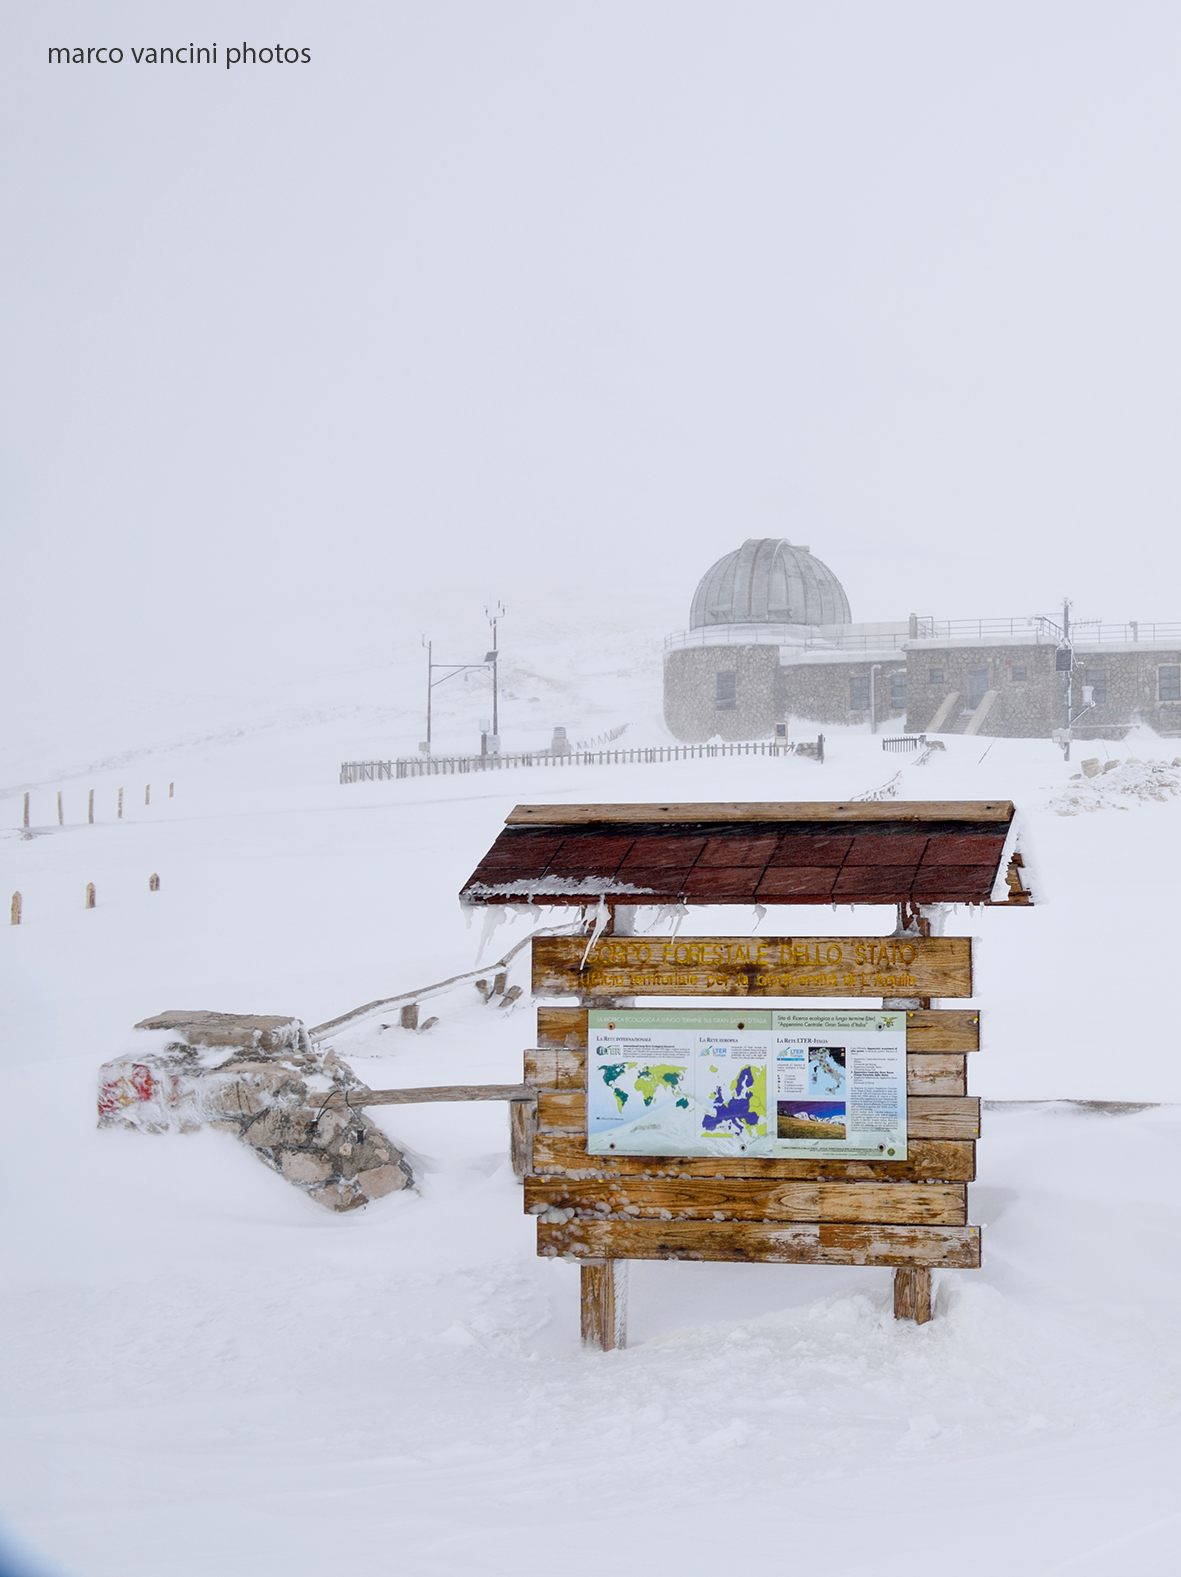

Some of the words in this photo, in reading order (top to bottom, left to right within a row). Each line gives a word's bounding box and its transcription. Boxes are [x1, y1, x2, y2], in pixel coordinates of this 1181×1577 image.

[584, 943, 652, 964] CORPO
[662, 943, 769, 965] FORESTALE
[780, 944, 843, 965] DELLO
[855, 944, 916, 965] STATO
[629, 972, 699, 986] territoriale
[706, 974, 731, 988] per
[737, 972, 749, 986] la
[843, 973, 856, 987] di
